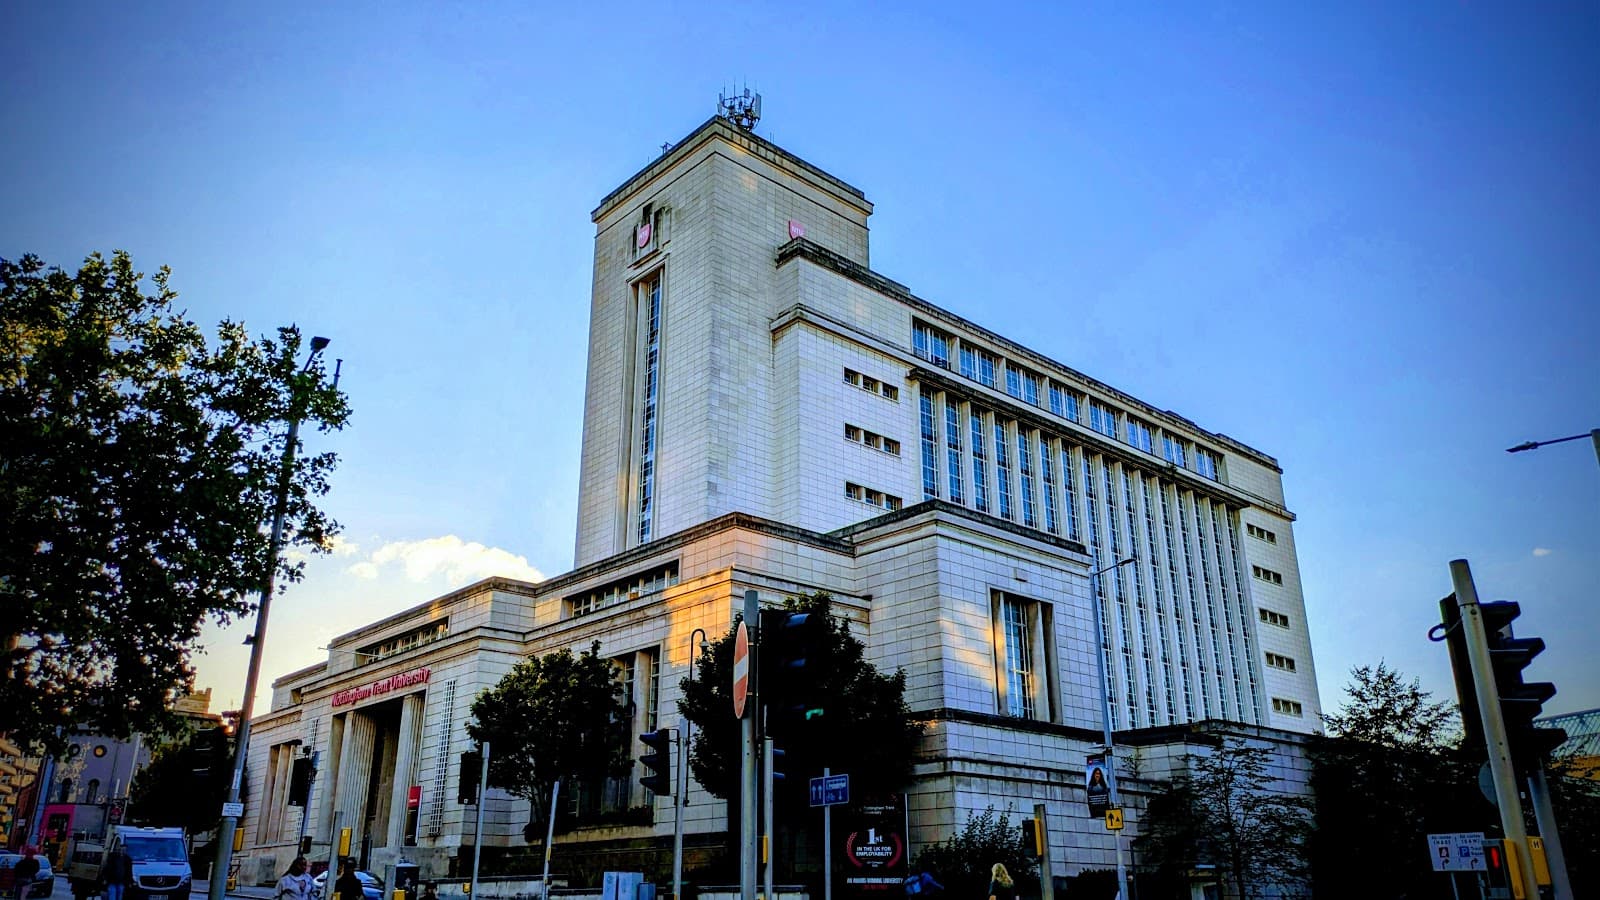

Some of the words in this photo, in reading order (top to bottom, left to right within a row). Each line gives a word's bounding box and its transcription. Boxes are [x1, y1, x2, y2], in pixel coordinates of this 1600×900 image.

[332, 687, 371, 707] Nottingham
[372, 680, 390, 696] Trent
[390, 667, 431, 689] University
[867, 828, 883, 845] 1st
